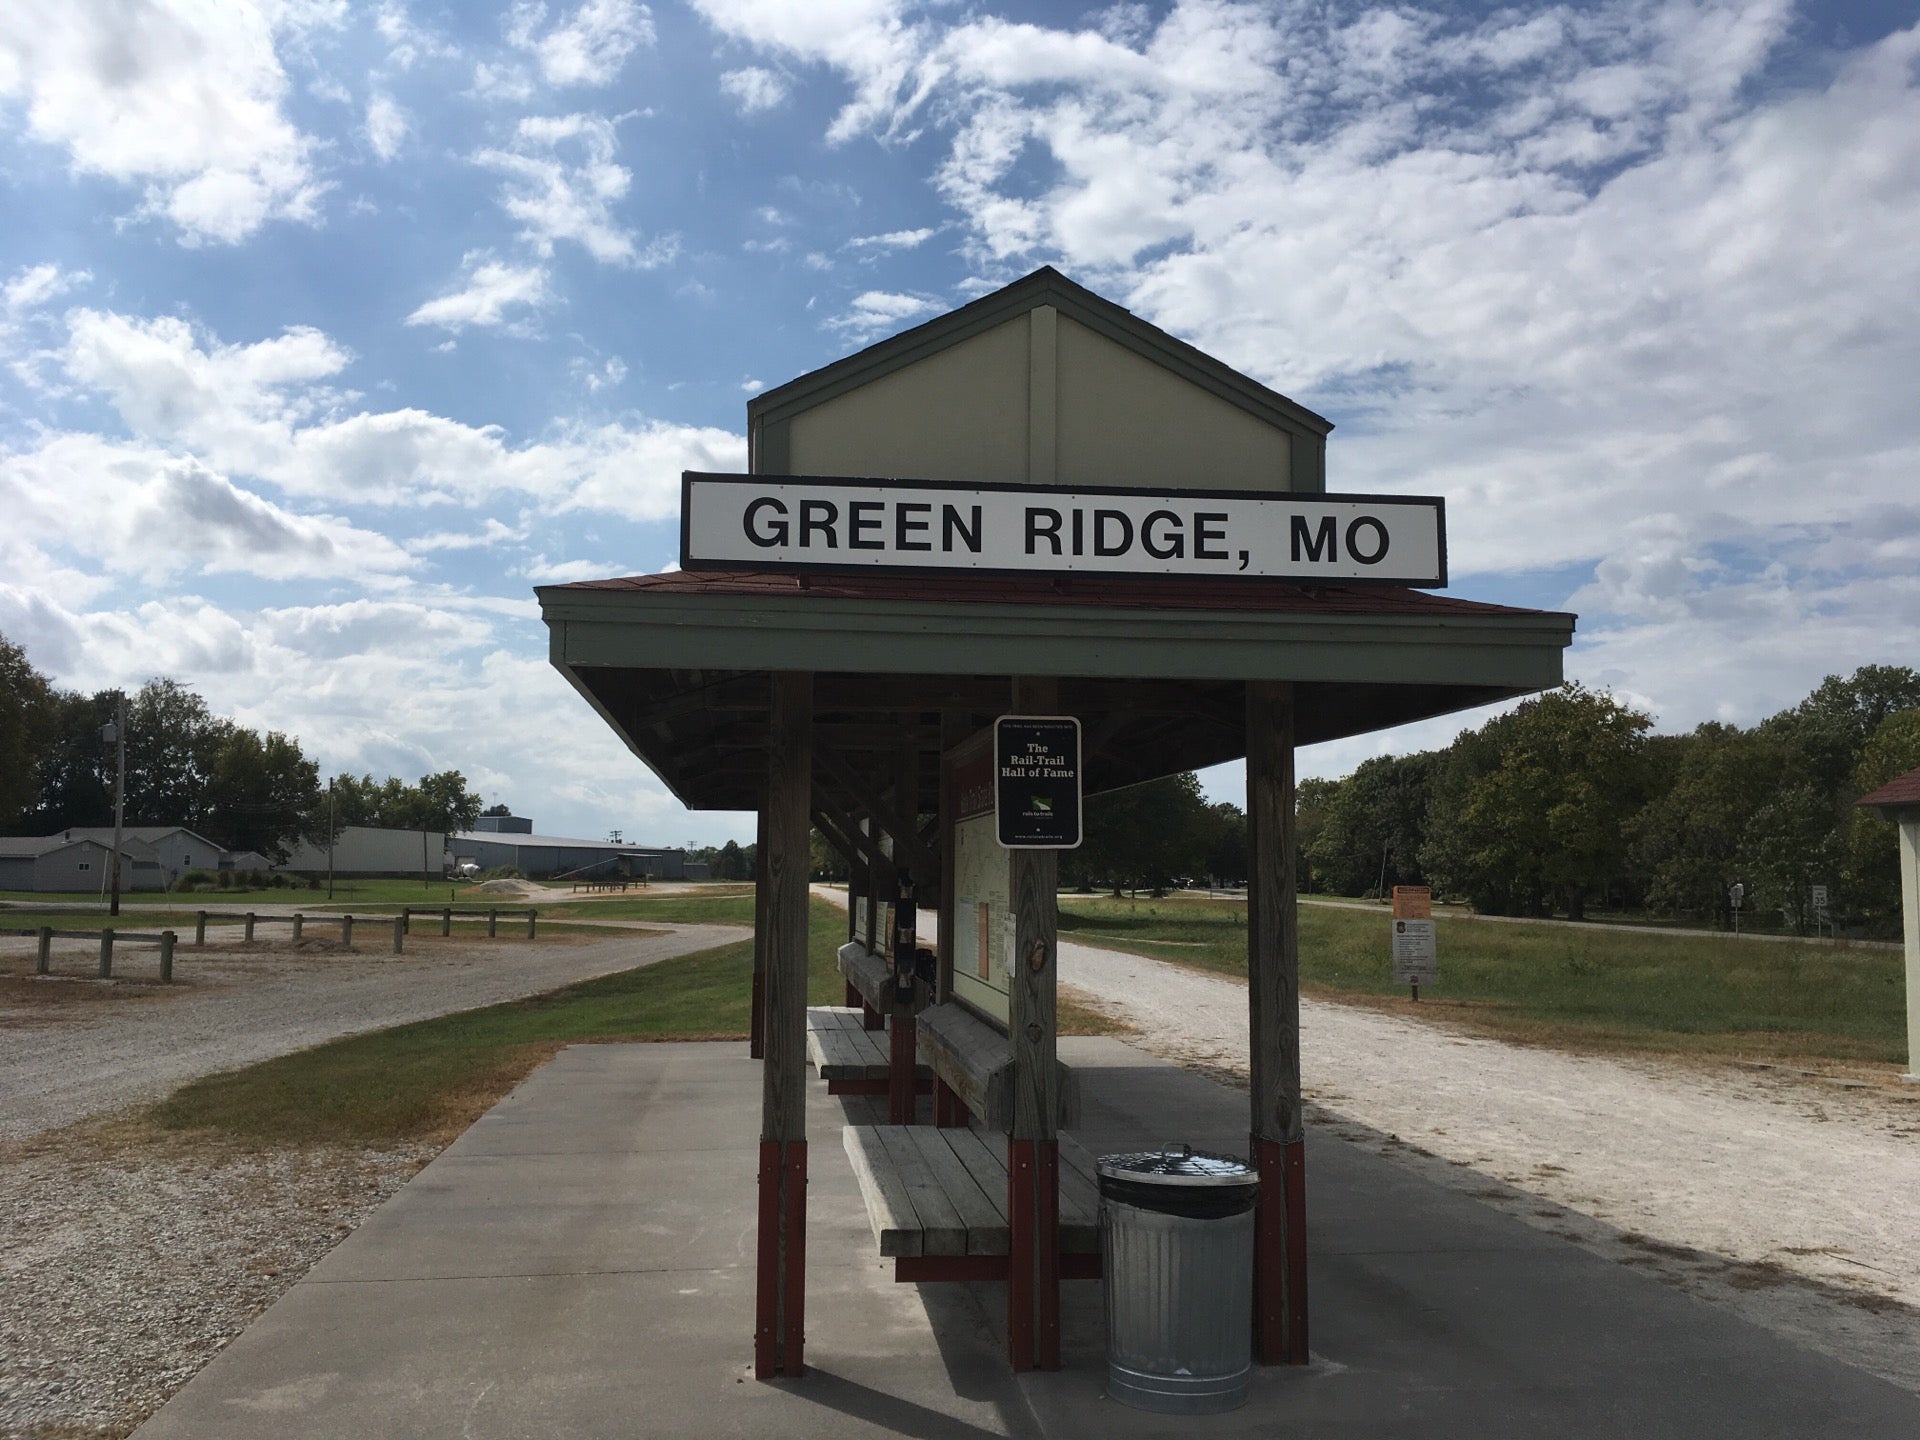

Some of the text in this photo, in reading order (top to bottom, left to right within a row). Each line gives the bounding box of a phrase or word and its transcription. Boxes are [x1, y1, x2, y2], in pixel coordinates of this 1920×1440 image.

[743, 496, 1390, 570] GREEN RIDGE, MO
[1027, 743, 1048, 753] The
[1010, 755, 1065, 766] Rail-Trail
[1001, 767, 1075, 778] Hall of Fame
